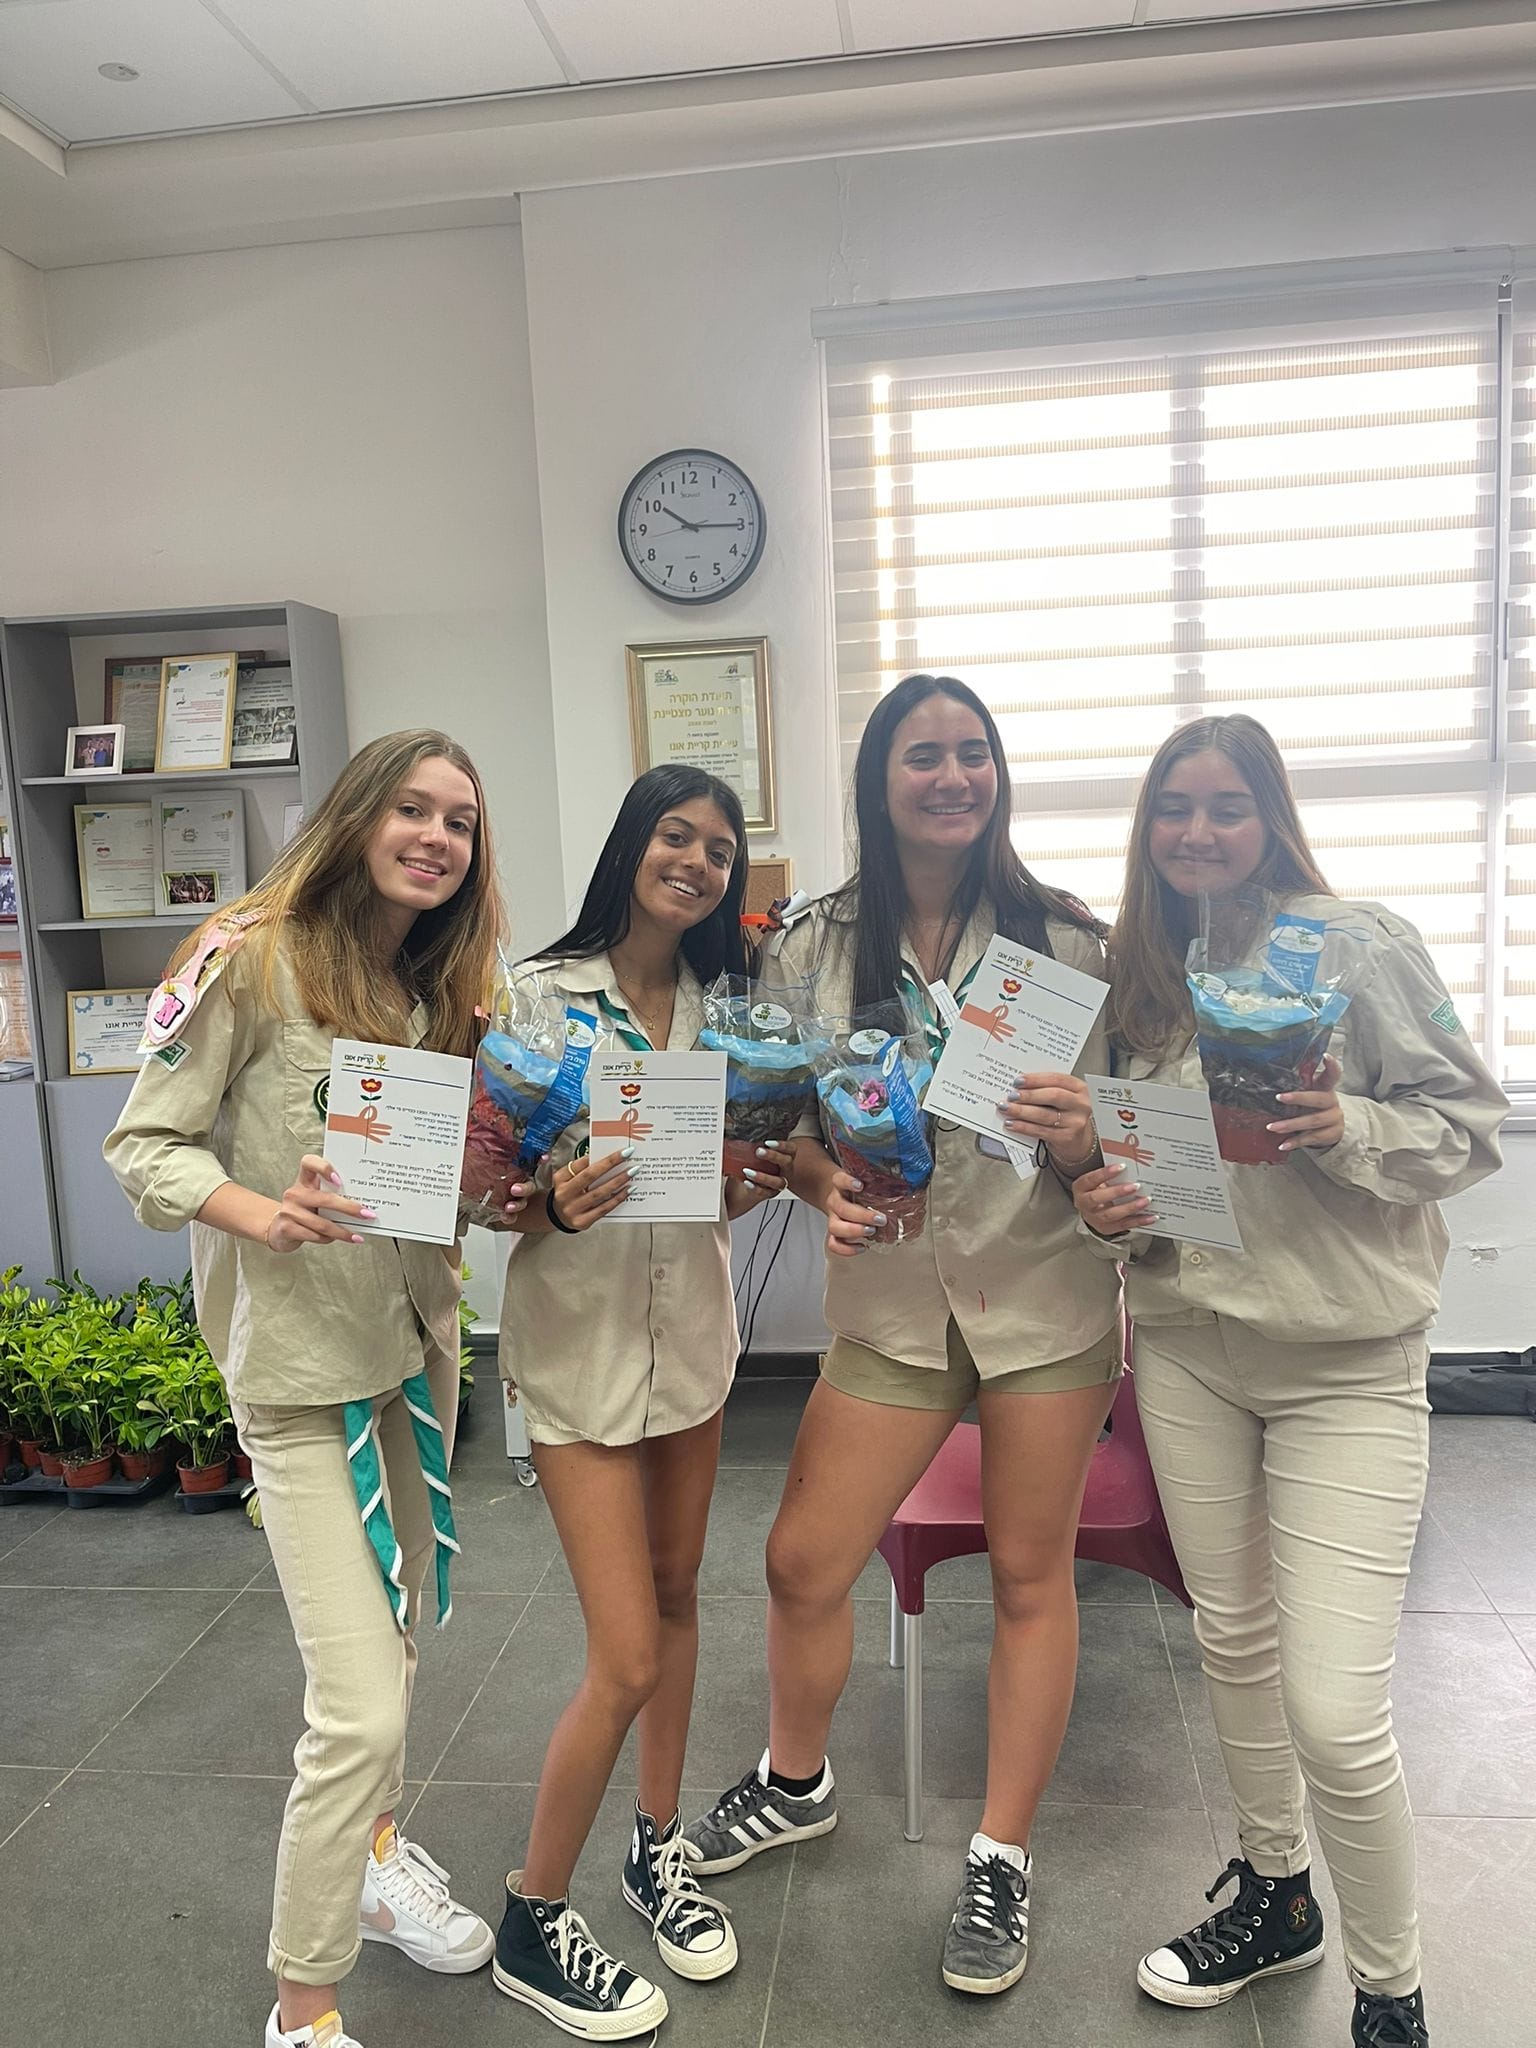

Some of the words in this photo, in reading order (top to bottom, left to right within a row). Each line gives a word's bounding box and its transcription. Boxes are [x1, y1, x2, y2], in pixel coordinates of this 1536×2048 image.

[682, 471, 698, 484] 12
[712, 476, 716, 488] 1
[661, 481, 675, 494] 11
[728, 493, 737, 506] 2
[645, 500, 661, 513] 10
[639, 524, 647, 536] 9
[737, 518, 745, 531] 3
[648, 548, 656, 561] 8
[729, 544, 738, 556] 4
[665, 565, 674, 578] 7
[713, 563, 721, 575] 5
[690, 571, 698, 583] 6
[670, 693, 698, 706] הוקרה
[695, 707, 714, 716] נוער
[688, 741, 710, 752] קריית
[712, 740, 738, 749] עיית
[357, 1055, 374, 1065] קריית
[614, 1064, 632, 1072] קריית
